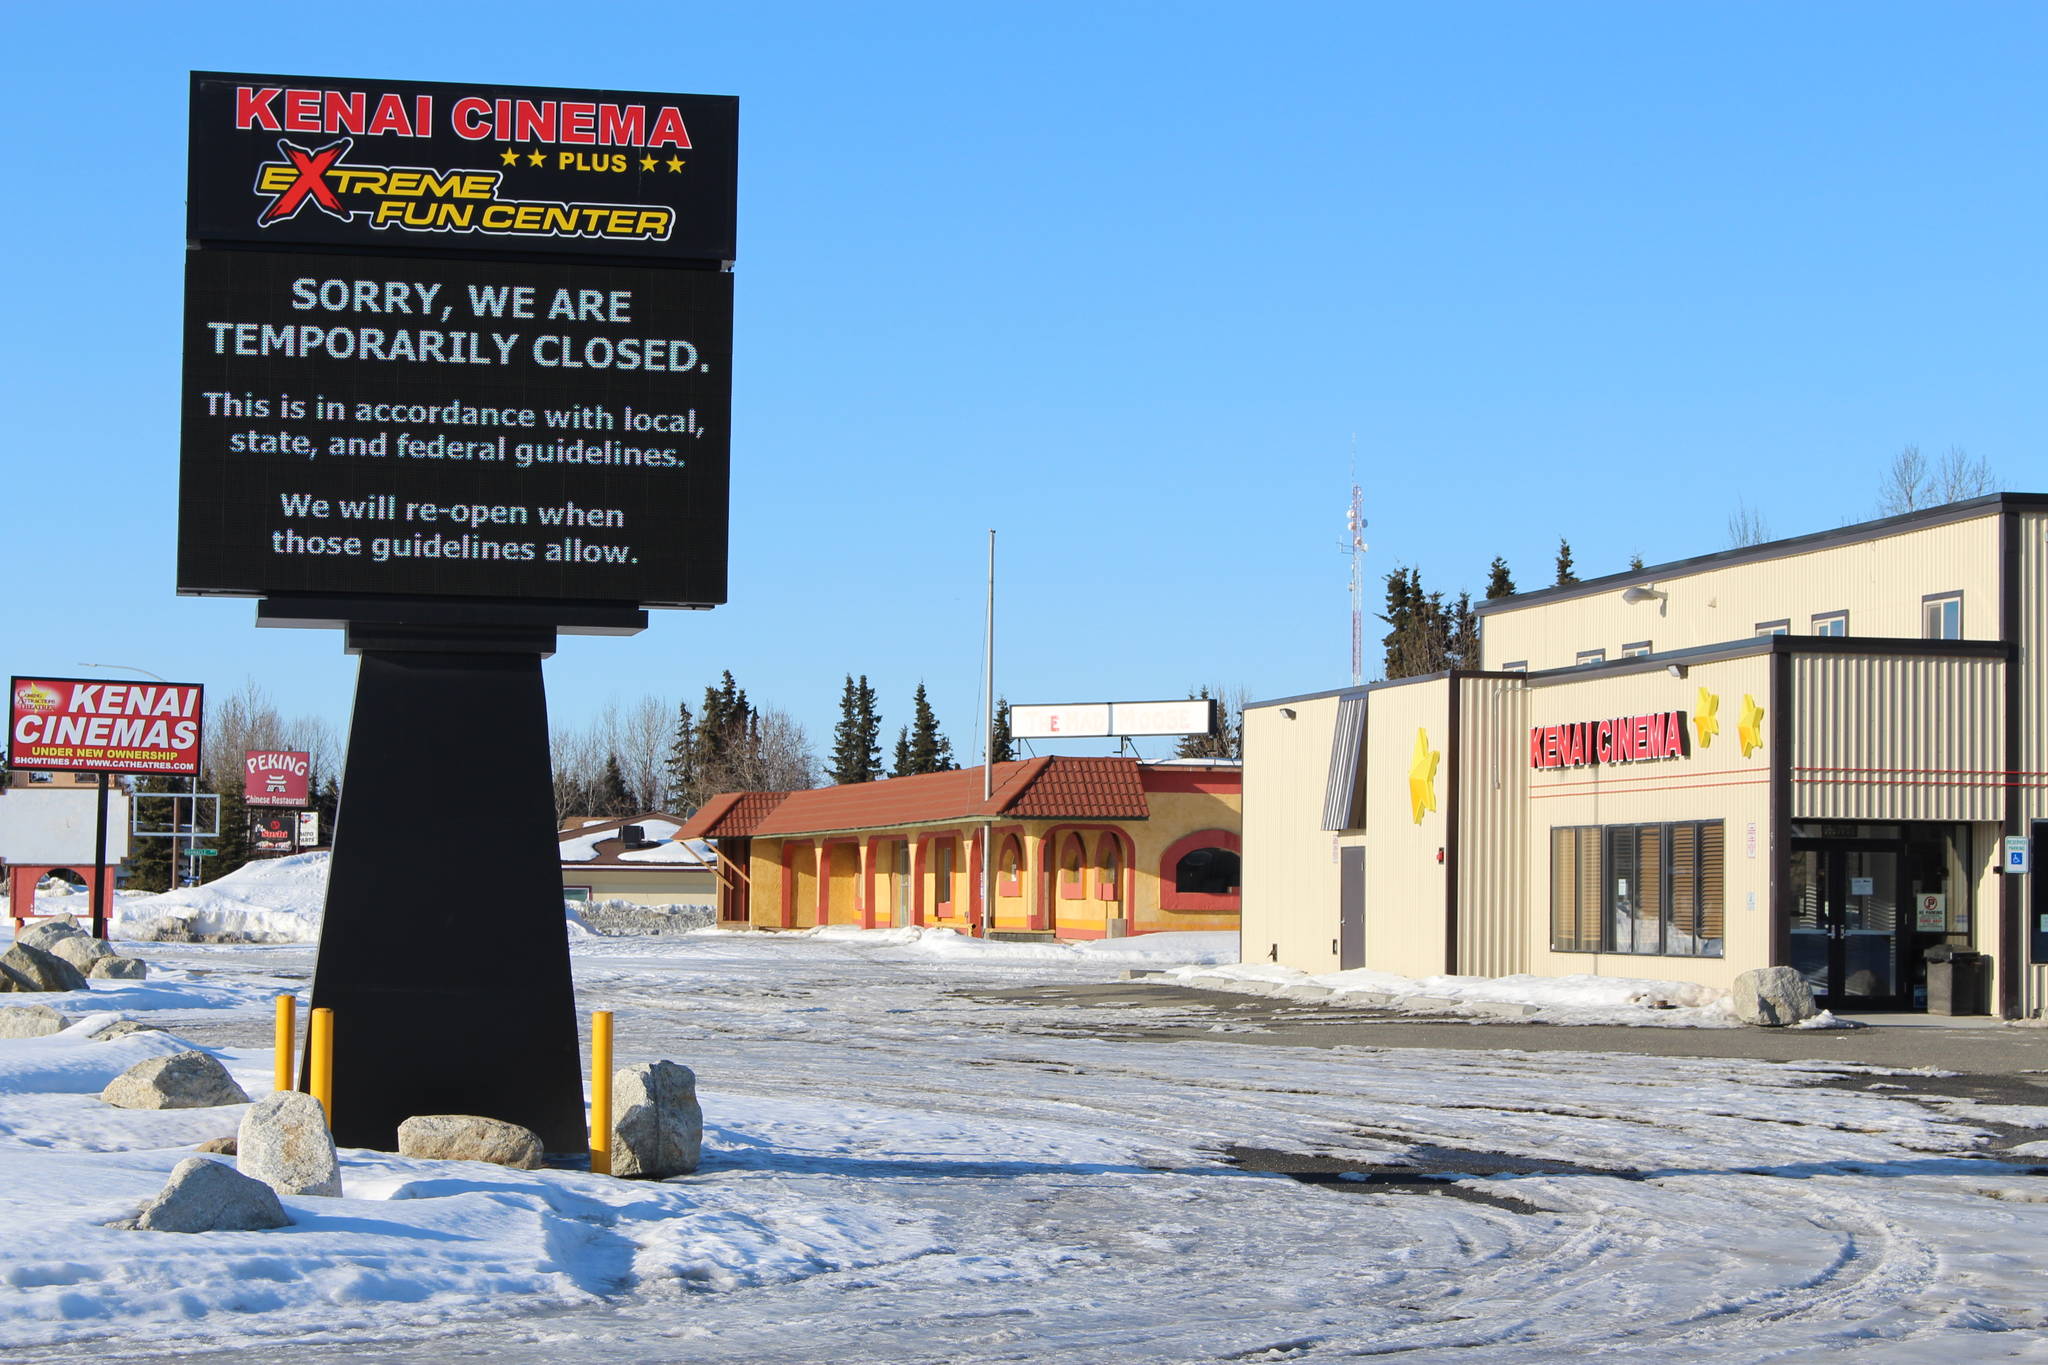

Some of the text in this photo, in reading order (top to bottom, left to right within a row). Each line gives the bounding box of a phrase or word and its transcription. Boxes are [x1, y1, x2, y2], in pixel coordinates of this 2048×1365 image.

[236, 86, 692, 149] KENAI CINEMA
[559, 152, 627, 173] PLUS
[258, 146, 496, 220] EXTREME
[376, 201, 669, 235] FUN CENTER
[292, 278, 632, 323] SORRY, WE ARE
[207, 322, 709, 373] TEMPORARILY CLOSED.
[202, 391, 704, 439] This is in accordance with local,
[229, 430, 686, 468] state, and federal guidelines.
[280, 493, 625, 528] We will re-open when
[272, 528, 639, 564] those guidelines allow.
[68, 684, 198, 717] KENAI
[15, 714, 197, 750] CINEMAS
[1530, 710, 1682, 769] KENAI CINEMA
[15, 756, 194, 770] SHOWTIMES AT WWW.CATHEATRES.COM
[32, 747, 178, 760] UNDER NEW OWNERSHIP
[247, 753, 307, 776] PEKING
[245, 795, 306, 805] Chinese Restaurant
